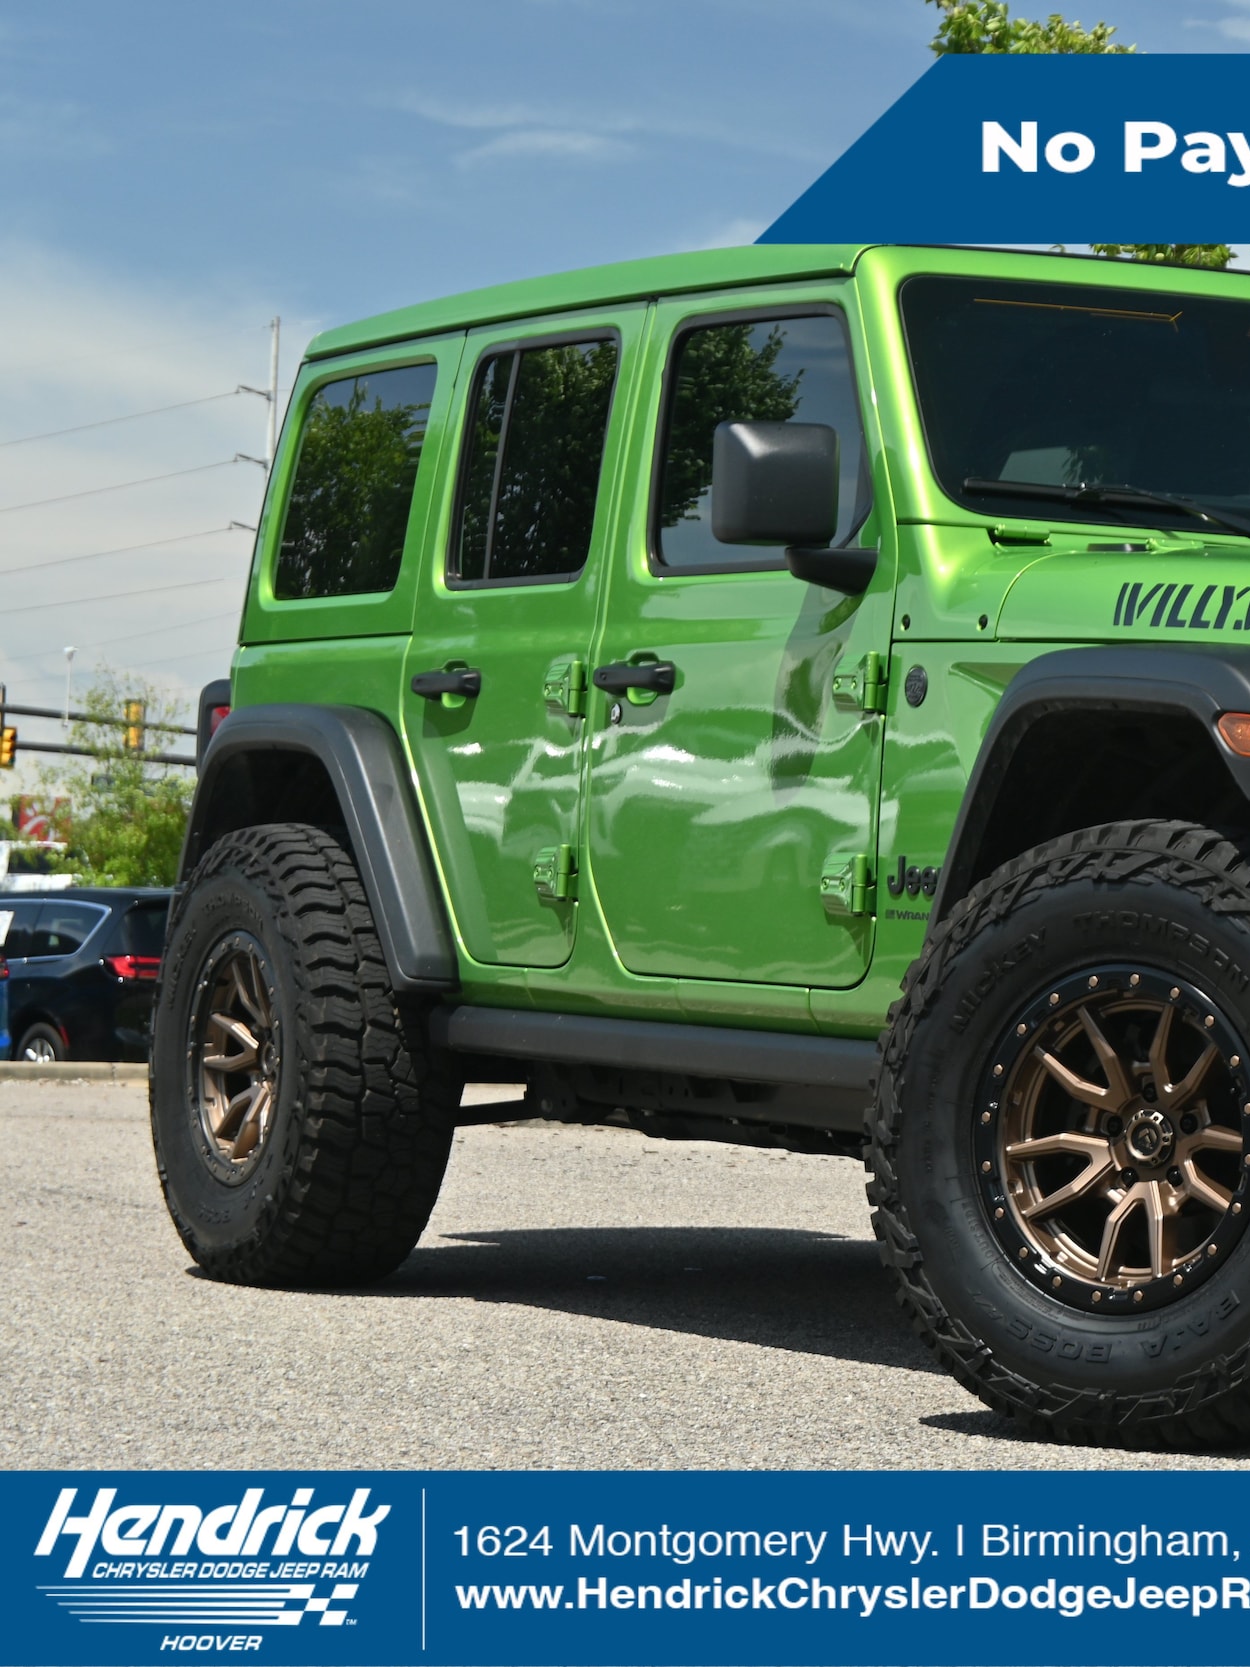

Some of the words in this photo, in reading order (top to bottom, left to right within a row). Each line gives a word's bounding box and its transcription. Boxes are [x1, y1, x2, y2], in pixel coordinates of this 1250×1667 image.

[887, 856, 942, 895] Jee
[896, 909, 931, 921] WRAN
[1072, 909, 1250, 992] THOMPSON
[1005, 1317, 1114, 1365] BOSS
